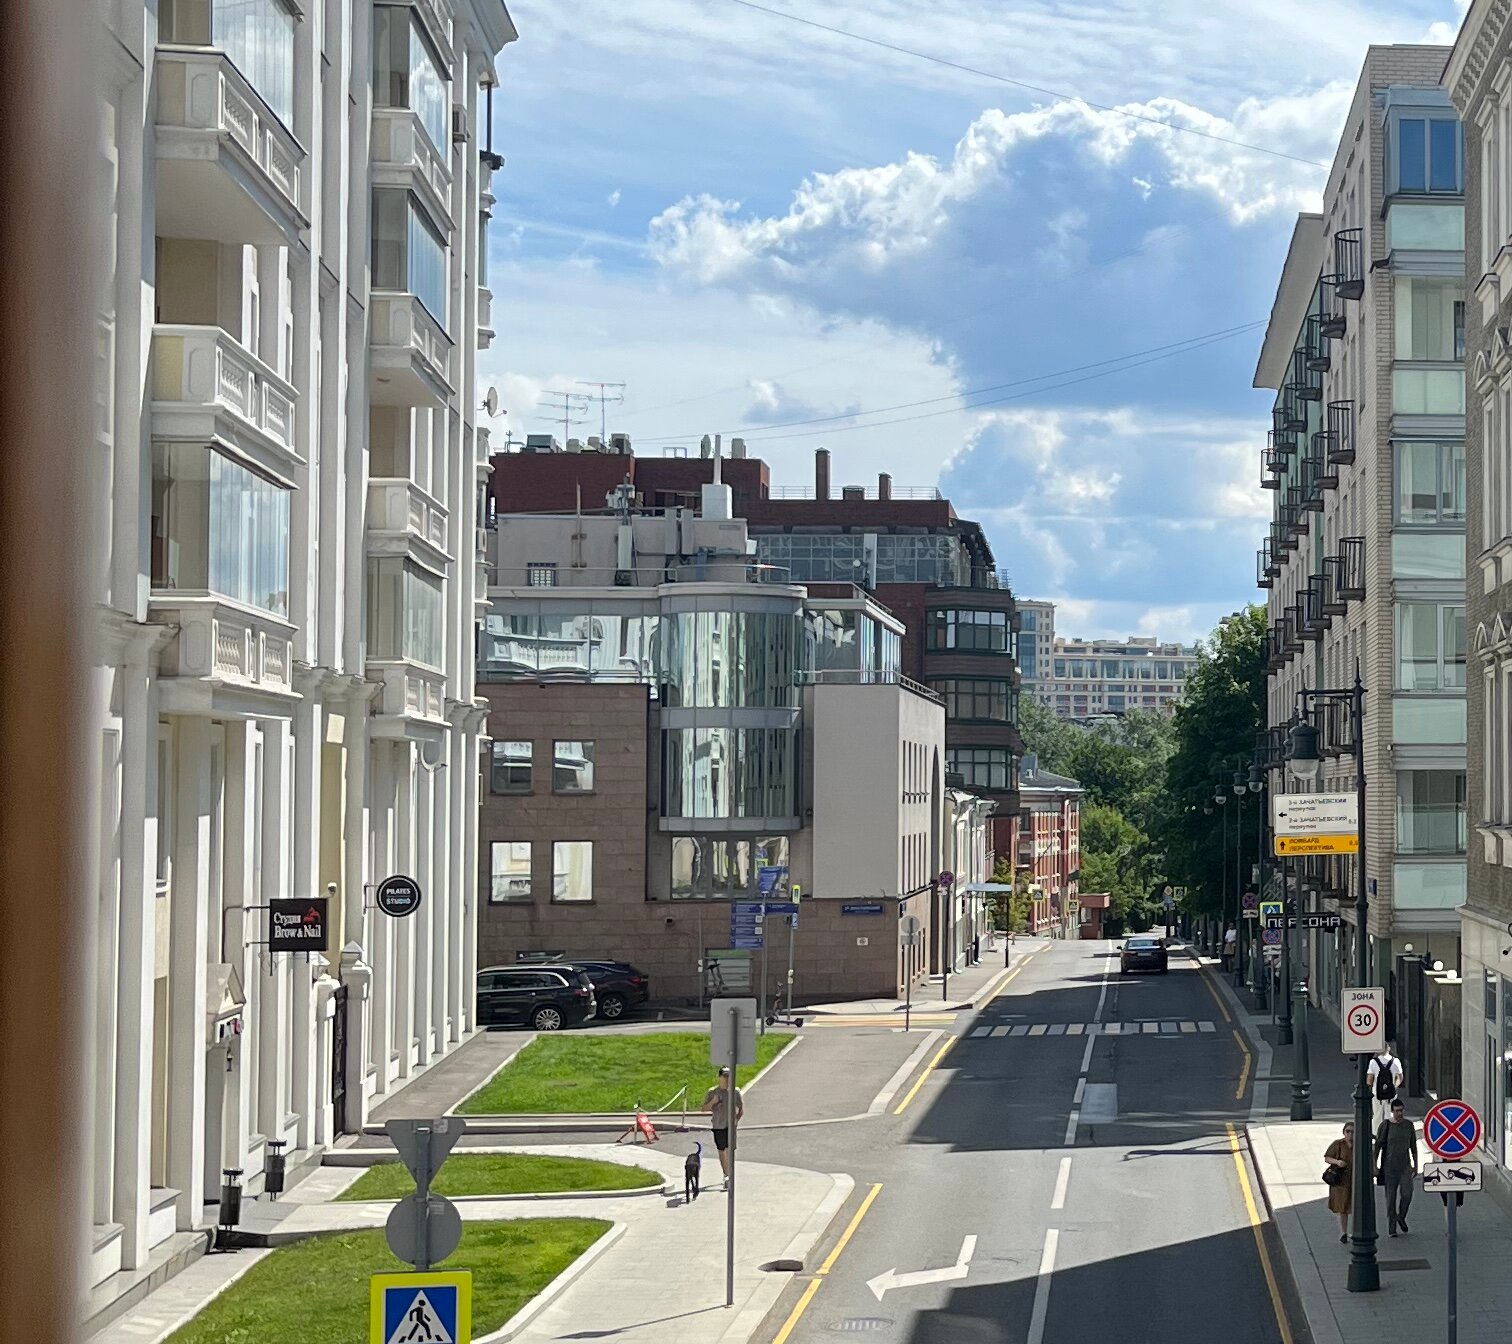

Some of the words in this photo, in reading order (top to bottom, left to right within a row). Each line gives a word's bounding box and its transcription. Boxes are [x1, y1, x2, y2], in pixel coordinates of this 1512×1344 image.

[386, 887, 411, 895] PILATES
[386, 897, 411, 905] STUDIO
[274, 925, 297, 938] Brow
[303, 924, 322, 938] Nail
[1351, 992, 1375, 1001] ЗОНА
[1354, 1013, 1372, 1027] 30
